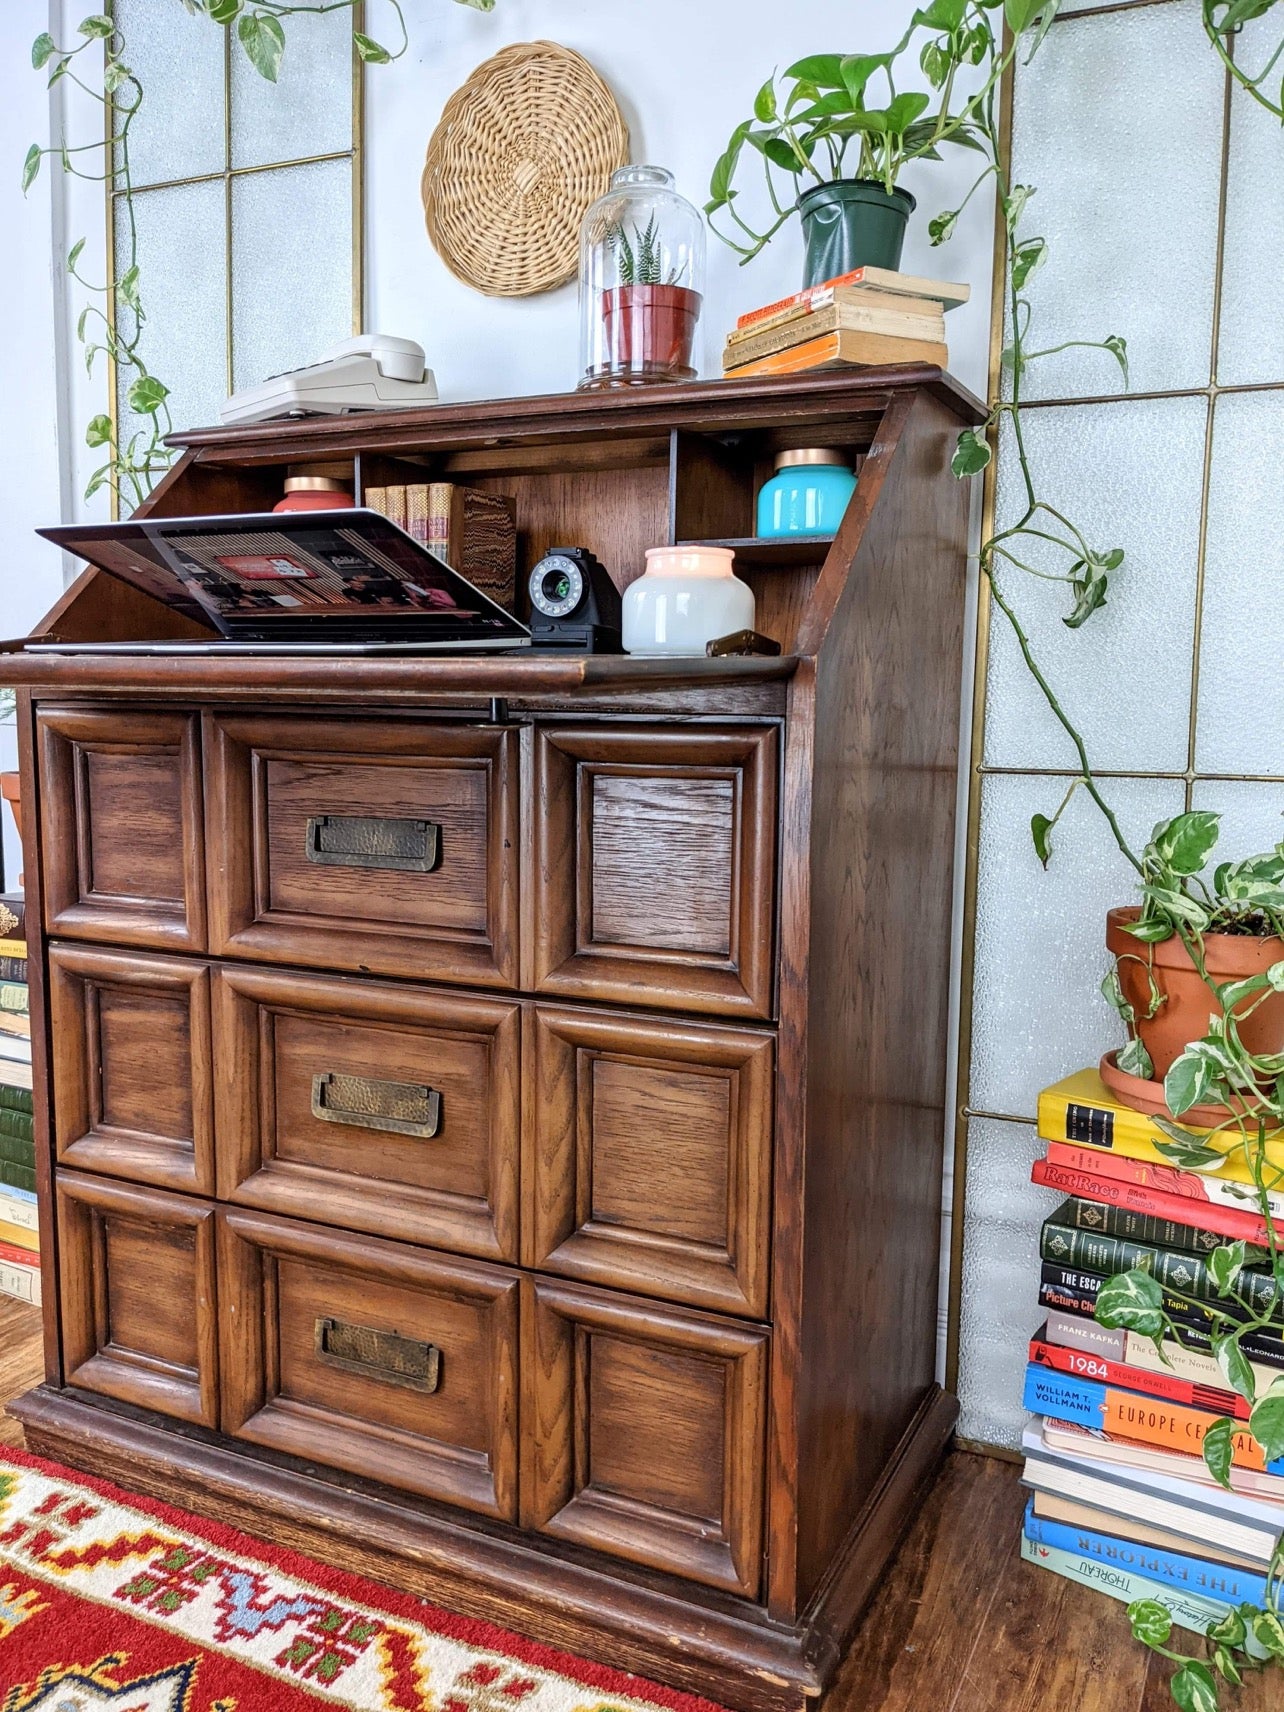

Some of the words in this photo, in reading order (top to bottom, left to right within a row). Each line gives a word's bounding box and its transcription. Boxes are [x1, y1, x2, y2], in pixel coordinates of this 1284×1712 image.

[1044, 1166, 1076, 1187] Rat
[1076, 1175, 1119, 1199] Race
[1061, 1271, 1077, 1286] THE
[1080, 1276, 1104, 1291] ESCA
[1046, 1289, 1079, 1308] Picture
[1167, 1298, 1188, 1311] Tapia
[1058, 1324, 1087, 1337] FRANZ
[1089, 1332, 1120, 1346] KAFKA
[1132, 1343, 1146, 1353] The
[1189, 1358, 1216, 1372] Novels
[1068, 1355, 1108, 1378] 1984
[1113, 1370, 1140, 1382] GEORGE
[1143, 1378, 1172, 1392] ORWELL
[1035, 1391, 1091, 1413] VOLLMANN
[1036, 1383, 1079, 1401] WILLIAM
[1082, 1391, 1091, 1404] T.
[1118, 1404, 1176, 1433] EUROPE
[1078, 1536, 1189, 1581] EXPLORER
[1079, 1561, 1131, 1594] THOREAU
[1196, 1577, 1241, 1597] THE
